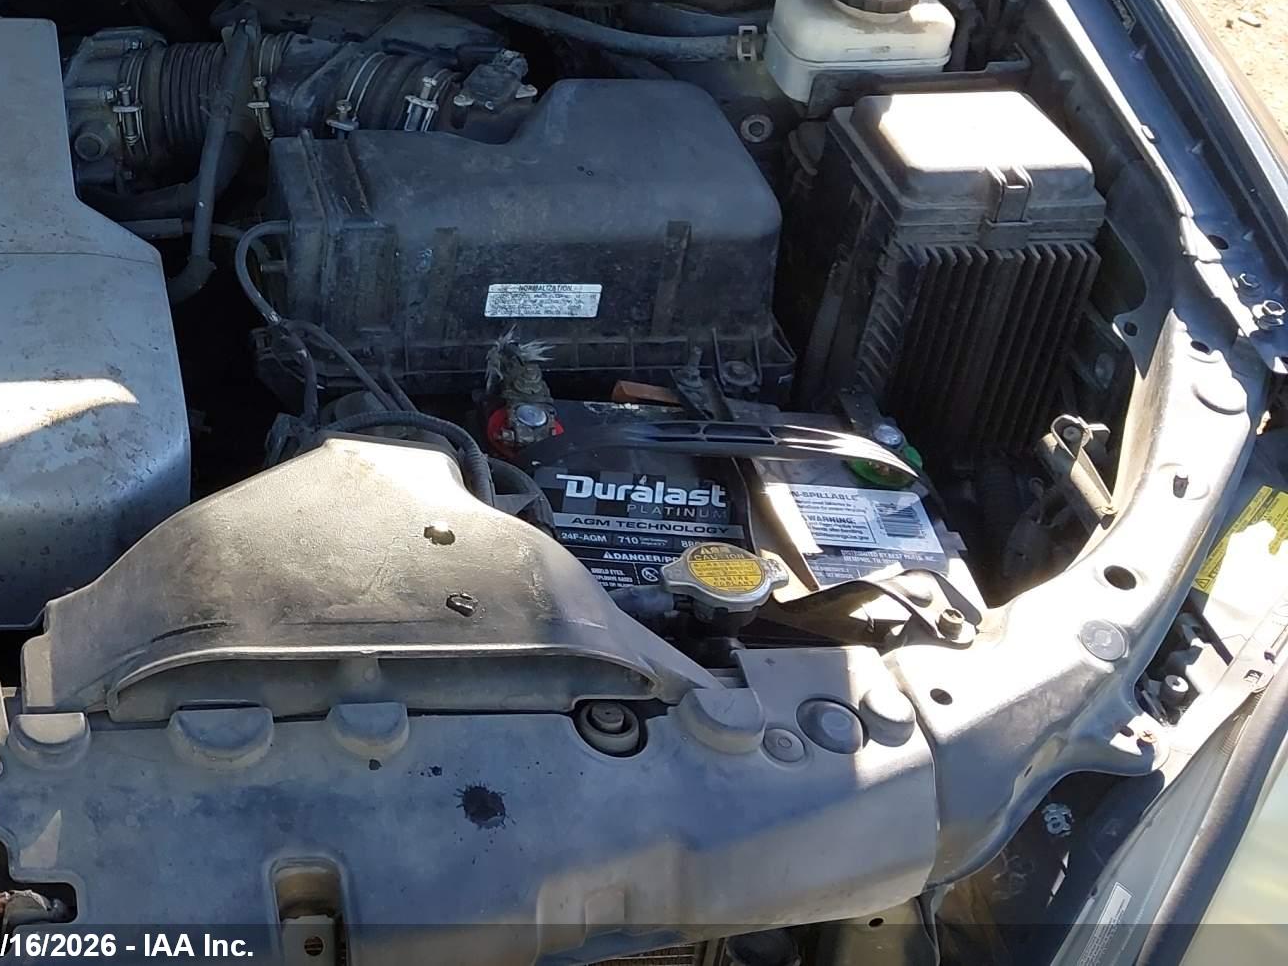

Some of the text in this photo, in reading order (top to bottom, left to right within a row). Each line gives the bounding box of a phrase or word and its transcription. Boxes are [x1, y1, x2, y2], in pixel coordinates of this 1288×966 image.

[555, 472, 728, 508] Duralast
[626, 503, 728, 519] PLATINUM
[571, 516, 730, 534] AGM TECHNOLOGY
[560, 531, 608, 543] 24F-AGM
[617, 535, 639, 545] 710
